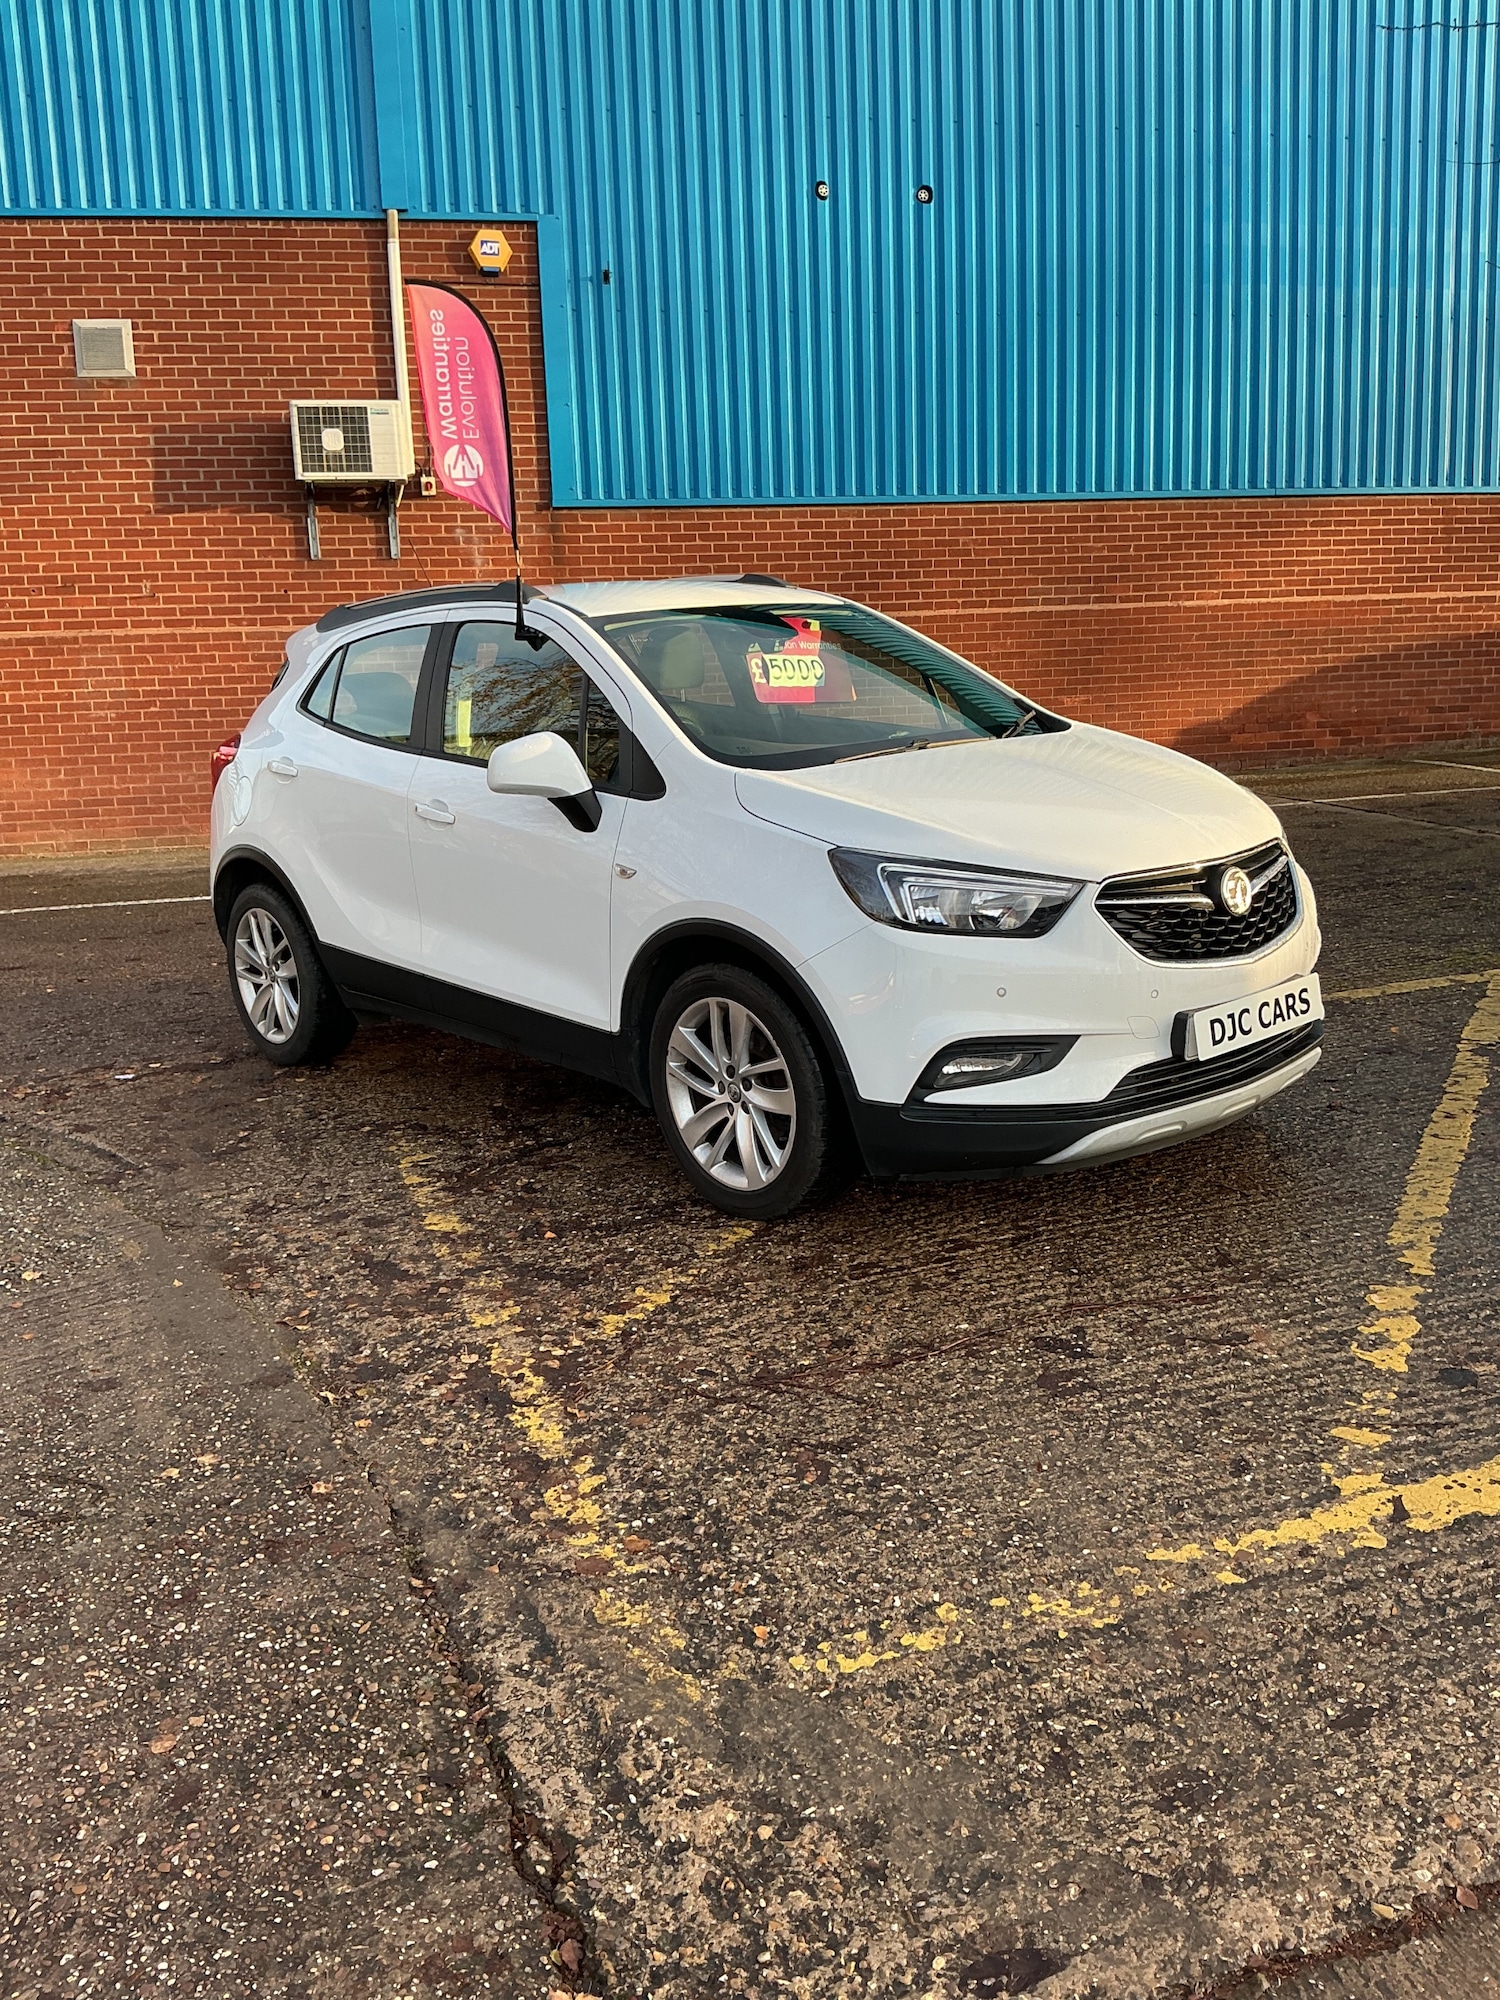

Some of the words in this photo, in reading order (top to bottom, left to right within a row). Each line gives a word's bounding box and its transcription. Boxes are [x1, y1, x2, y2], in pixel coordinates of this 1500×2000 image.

[481, 242, 500, 255] ADT
[799, 641, 841, 650] Warranties
[1210, 1008, 1252, 1046] DJC
[1258, 988, 1311, 1028] CARS
